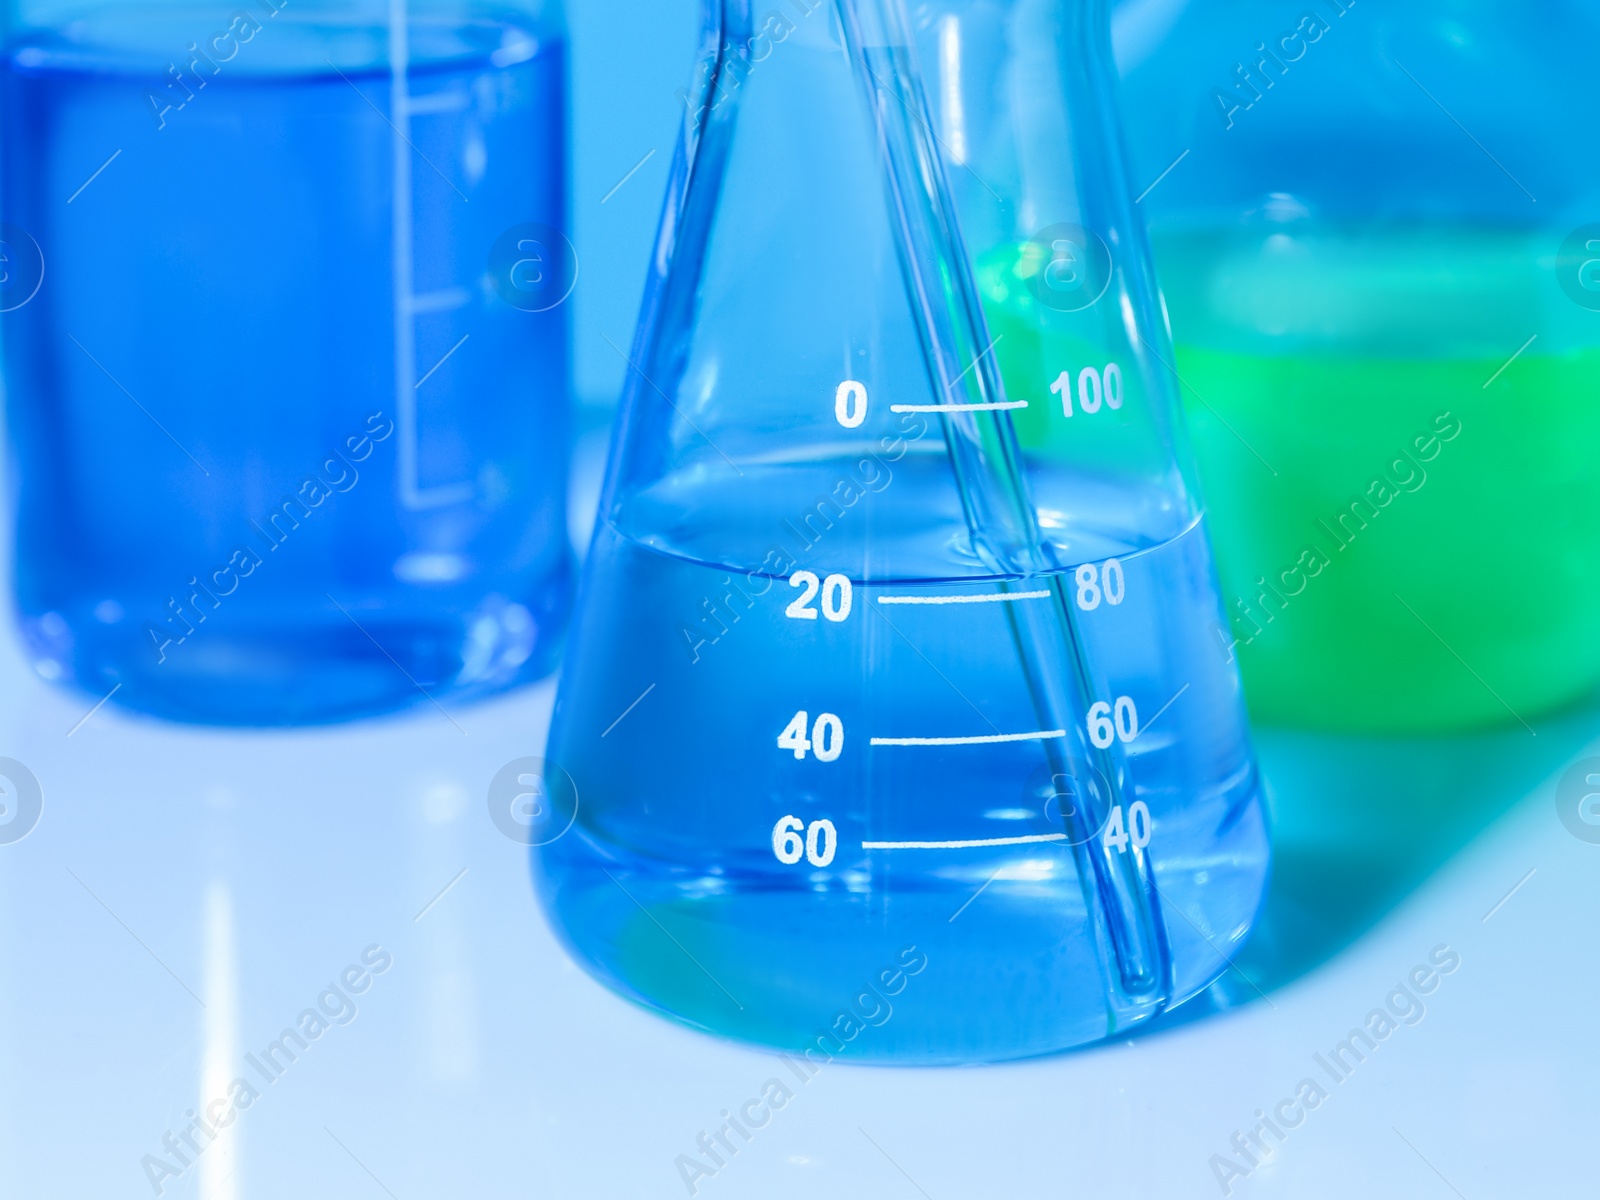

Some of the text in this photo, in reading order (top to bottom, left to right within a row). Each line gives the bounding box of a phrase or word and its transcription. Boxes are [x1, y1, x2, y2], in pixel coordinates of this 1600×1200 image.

[834, 379, 868, 428] 0
[1050, 363, 1124, 418] 100
[785, 570, 853, 622] 20
[1075, 558, 1125, 611] 80
[777, 710, 845, 762] 40
[1086, 695, 1138, 749] 60
[772, 815, 837, 867] 60
[1103, 801, 1151, 853] 40
